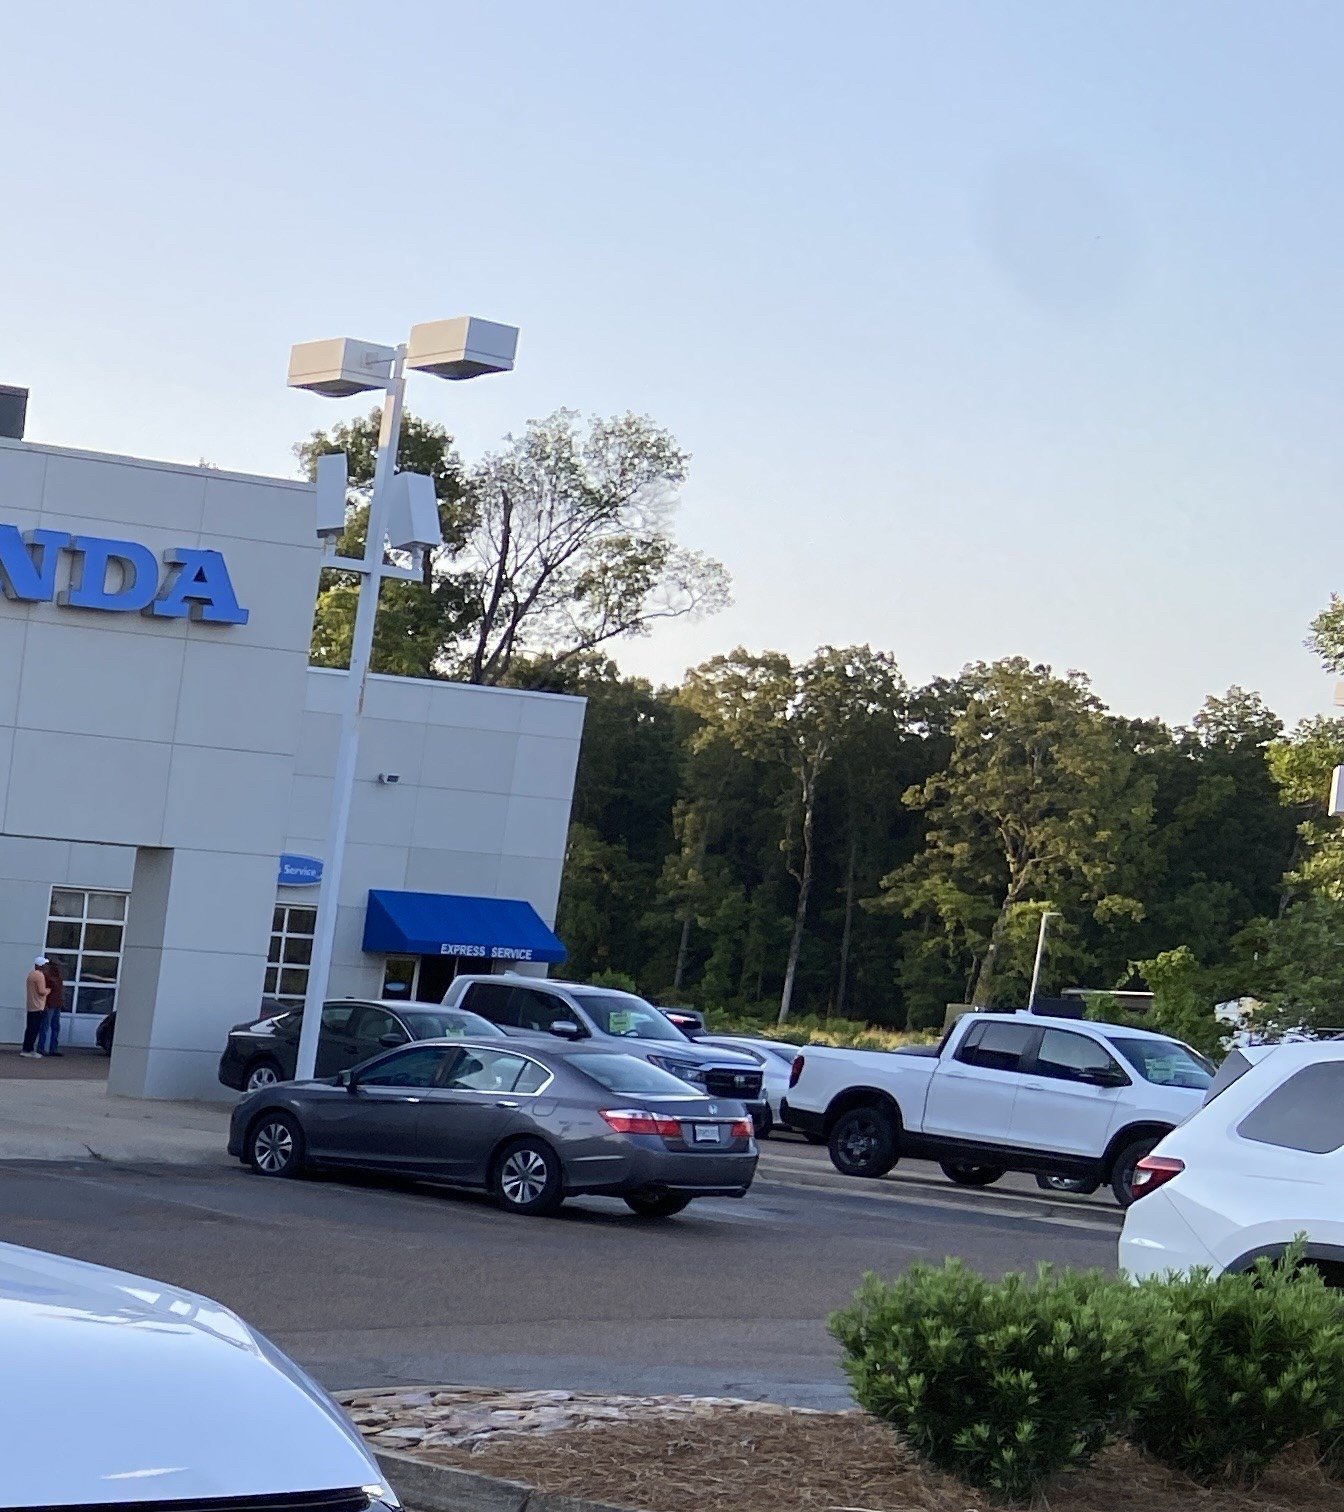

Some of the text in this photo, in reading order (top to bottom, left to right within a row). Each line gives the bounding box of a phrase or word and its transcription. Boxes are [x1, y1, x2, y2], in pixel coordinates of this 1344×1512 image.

[283, 863, 317, 877] Service
[440, 943, 533, 961] EXPRESS SERVICE
